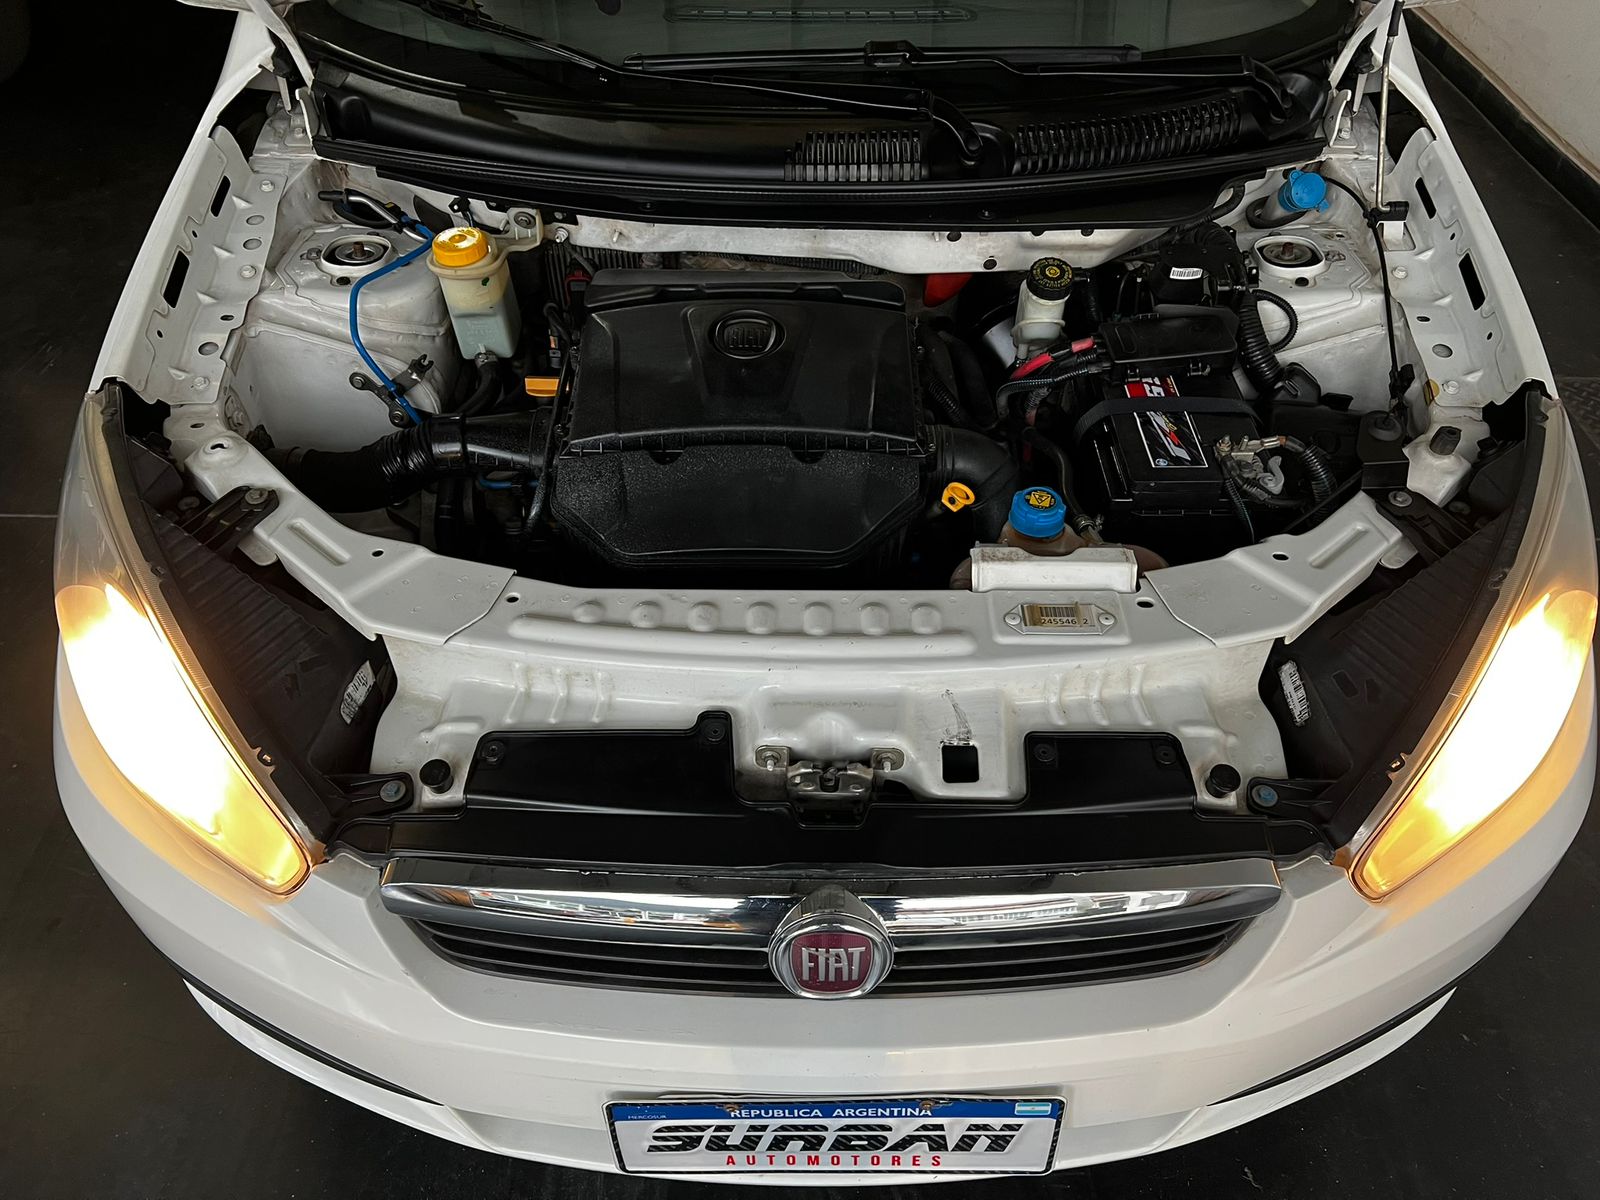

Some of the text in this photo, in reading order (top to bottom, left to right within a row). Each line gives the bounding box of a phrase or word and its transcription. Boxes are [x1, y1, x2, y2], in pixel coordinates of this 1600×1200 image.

[801, 946, 866, 981] FIAT
[730, 1107, 932, 1119] REPUBLICA ARGENTINA
[726, 1154, 942, 1167] AUTOMOTORES
